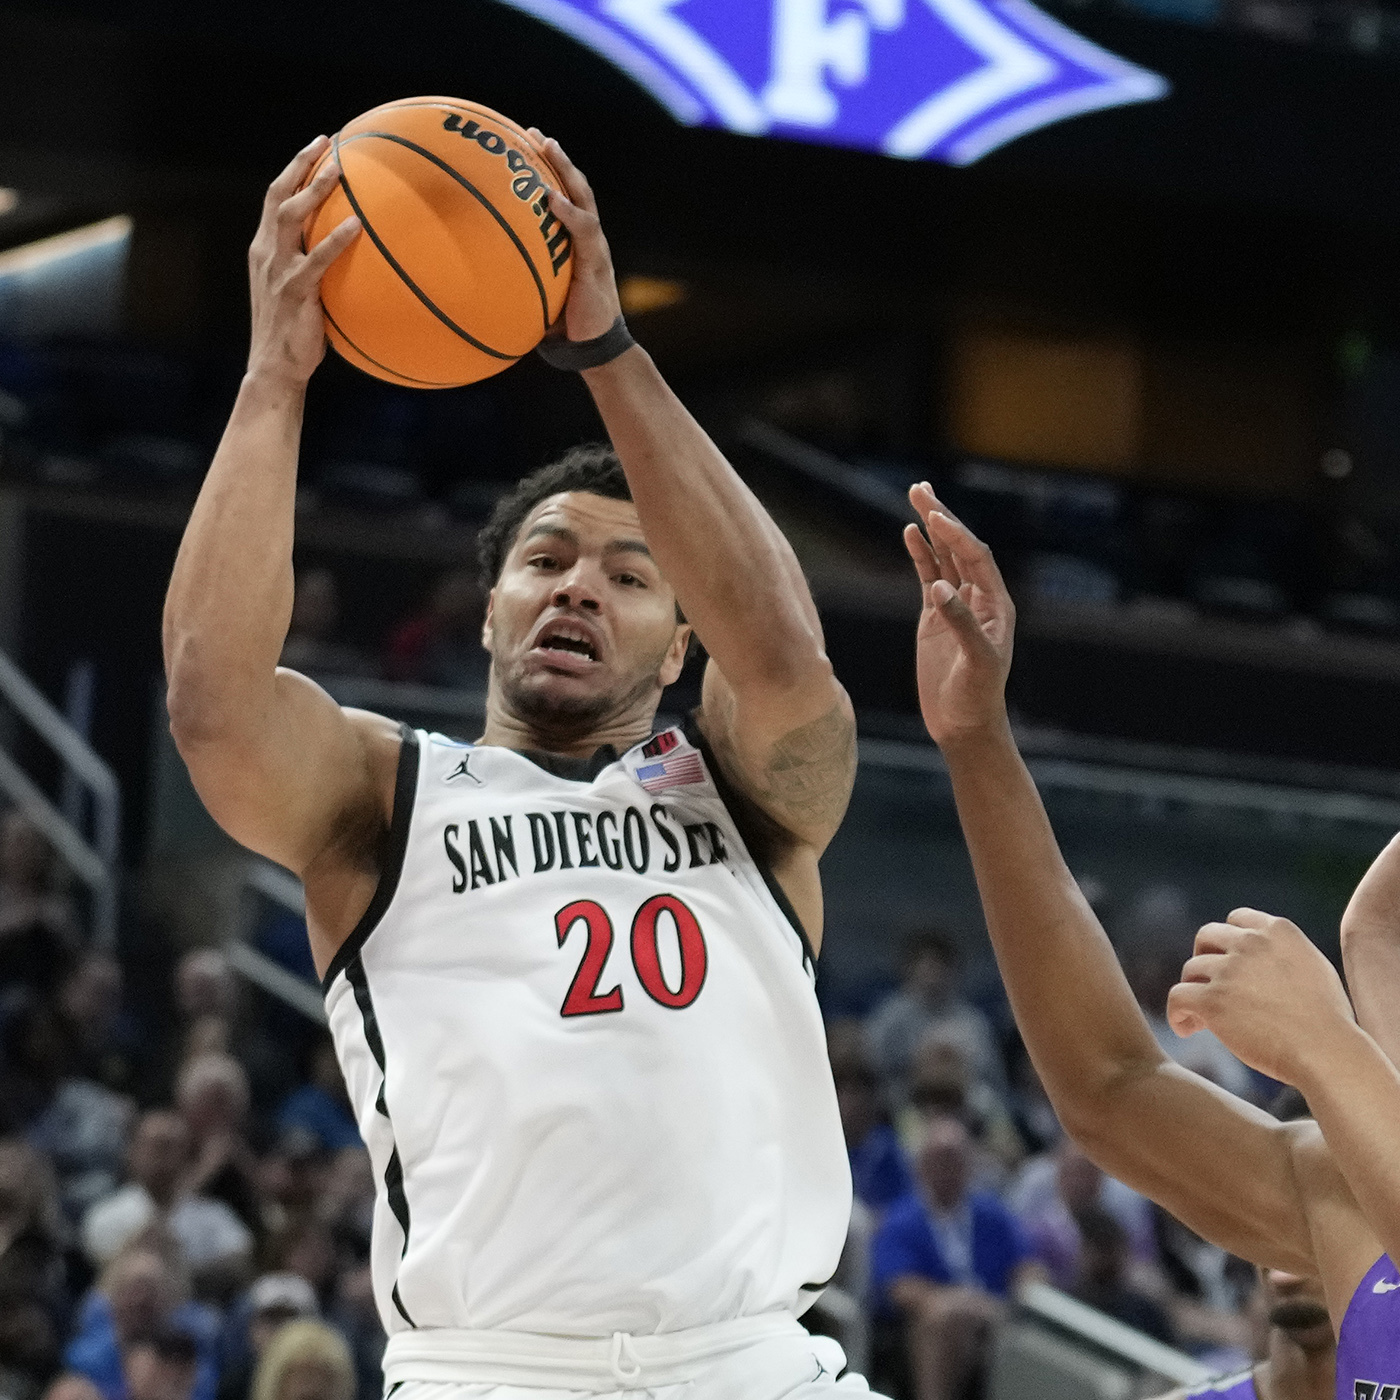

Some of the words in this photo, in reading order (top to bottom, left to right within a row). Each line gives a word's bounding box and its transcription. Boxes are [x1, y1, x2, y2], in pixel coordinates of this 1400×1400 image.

[443, 815, 520, 893] SAN
[525, 806, 651, 874] DIEGO
[554, 893, 709, 1018] 20
